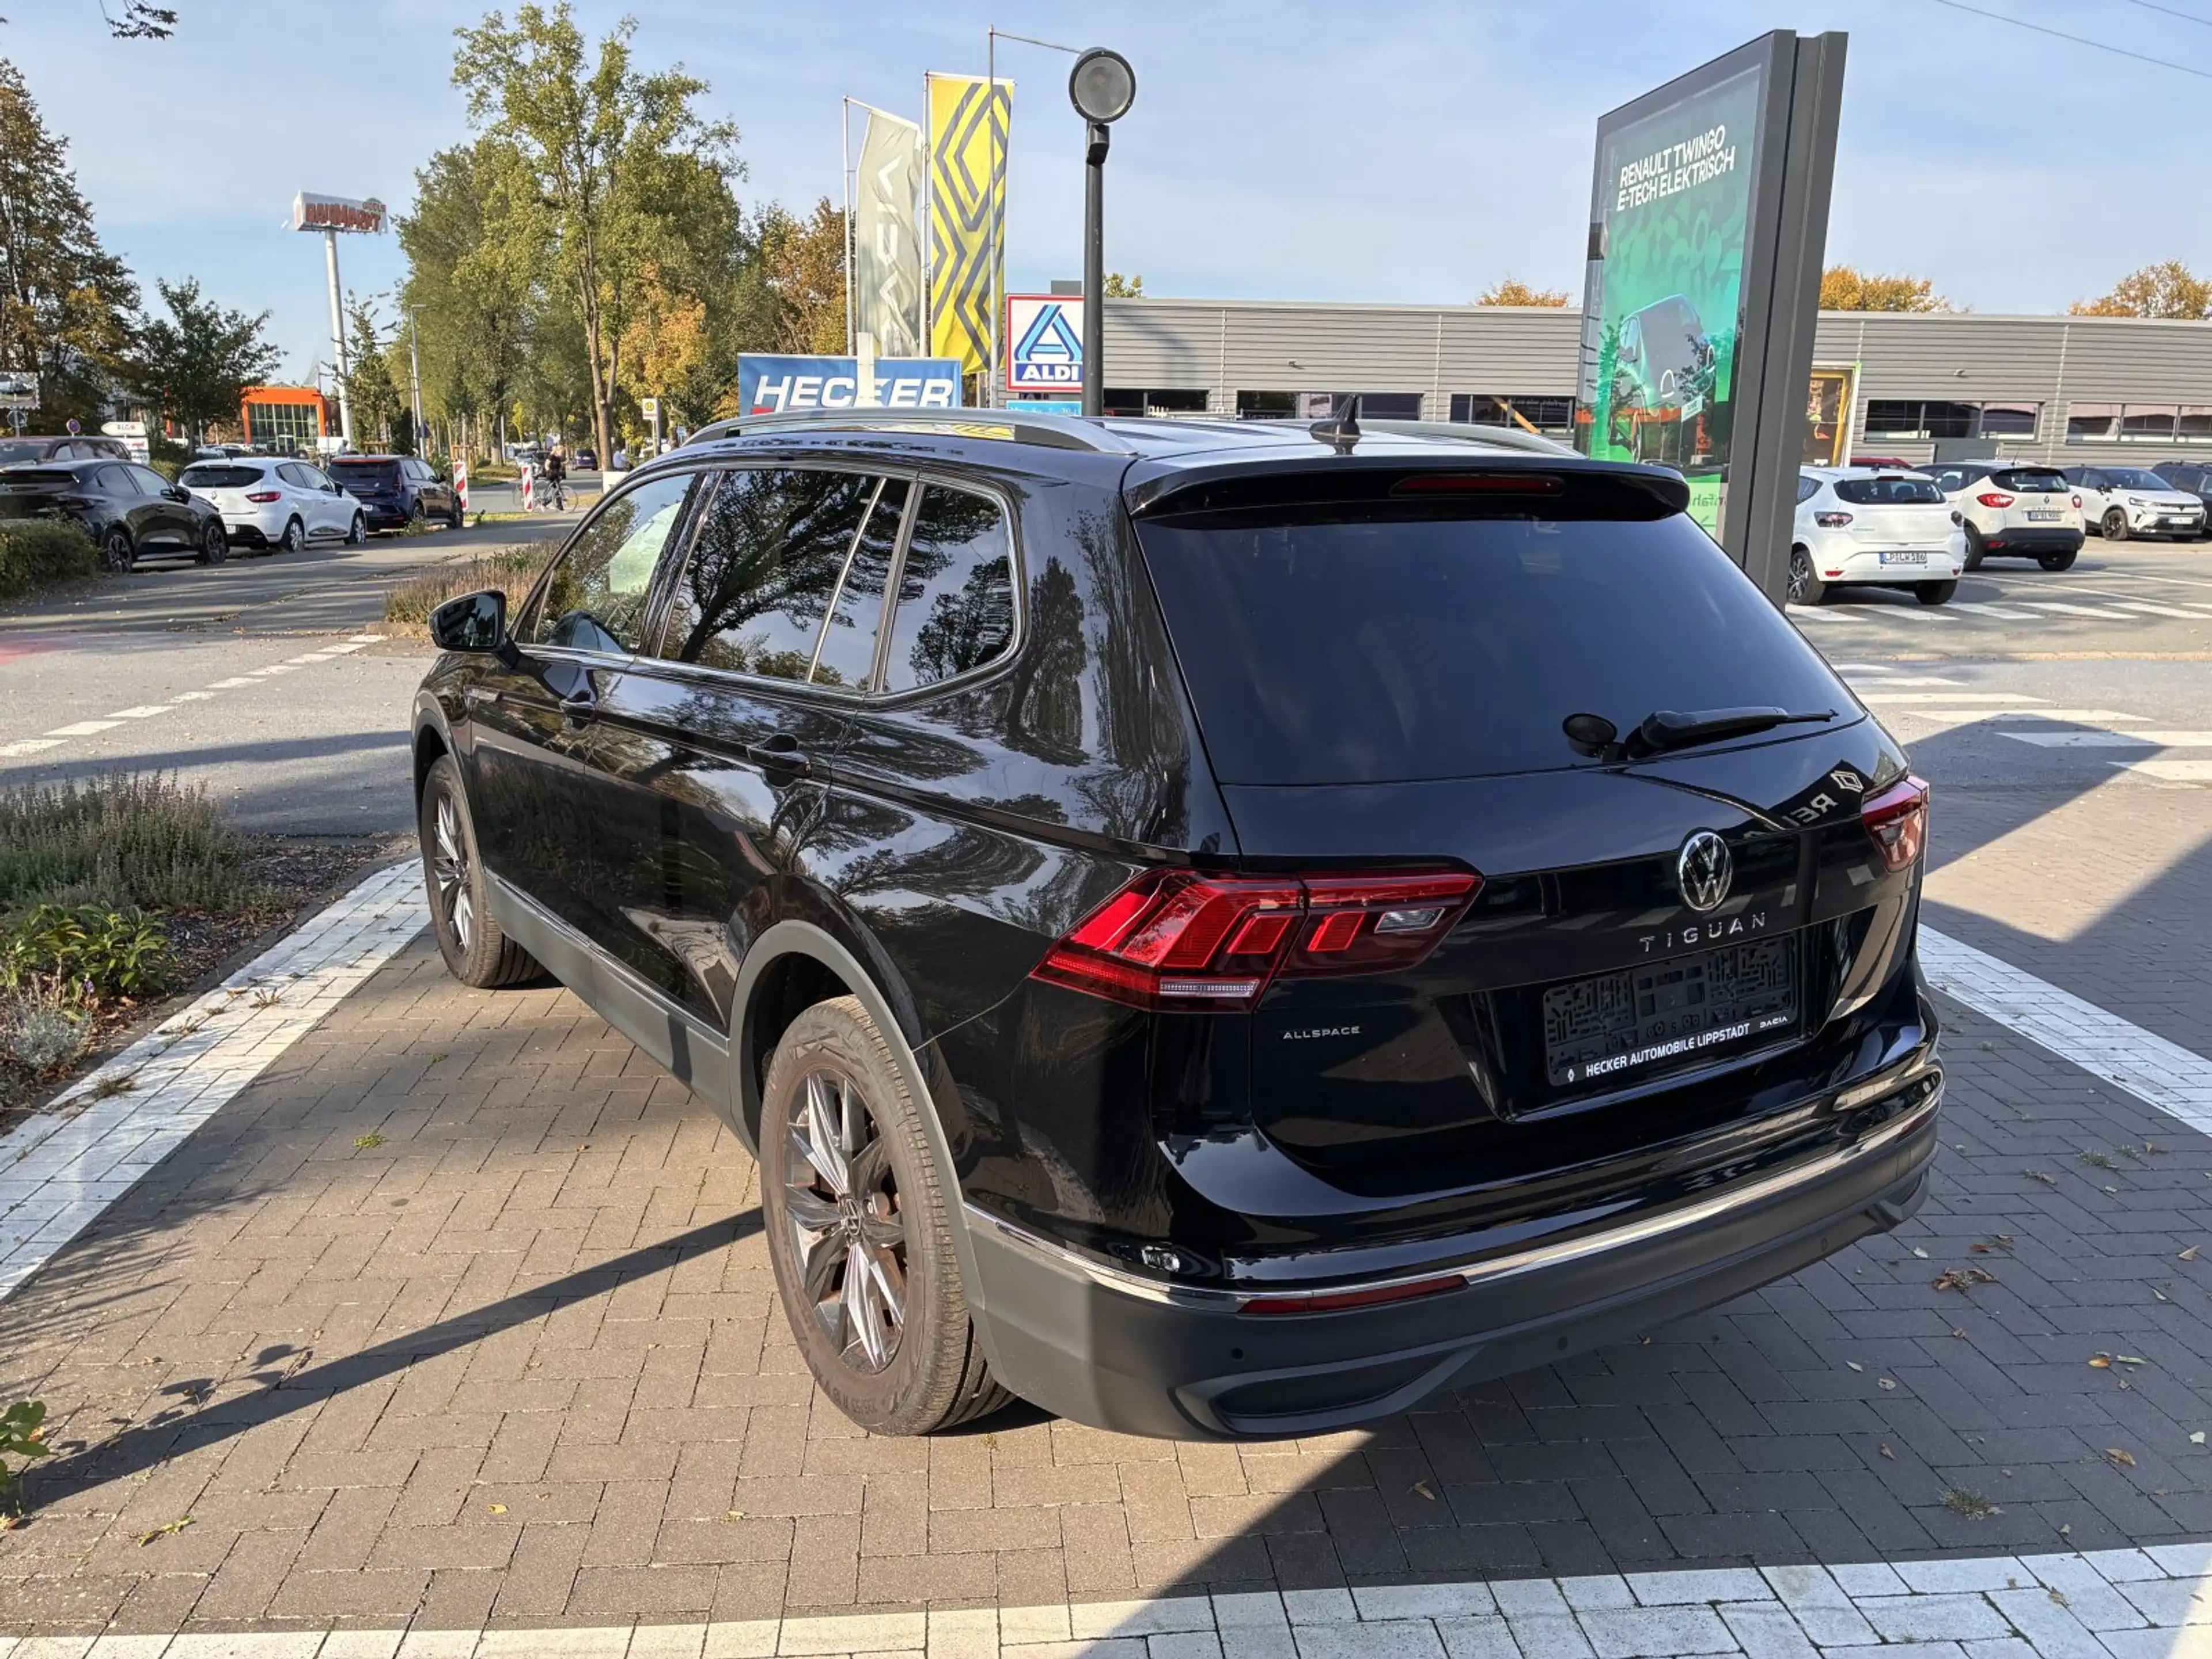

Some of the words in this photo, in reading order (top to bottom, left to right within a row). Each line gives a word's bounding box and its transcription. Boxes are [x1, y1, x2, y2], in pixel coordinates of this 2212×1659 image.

[1616, 177, 1658, 212] E-TECH
[1659, 145, 1736, 198] ELEKTRISCH
[1620, 147, 1672, 188] RENAULT
[1673, 124, 1726, 168] TWINGO
[1021, 365, 1079, 381] ALDI
[1639, 912, 1766, 952] TIGUAN
[1282, 1025, 1361, 1040] ALLSPACE
[1586, 1055, 1628, 1077] HECKER
[1630, 1037, 1695, 1065] AUTOMOBILE
[1697, 1022, 1751, 1047] LIPPSTADT
[1759, 1016, 1789, 1028] DACIA
